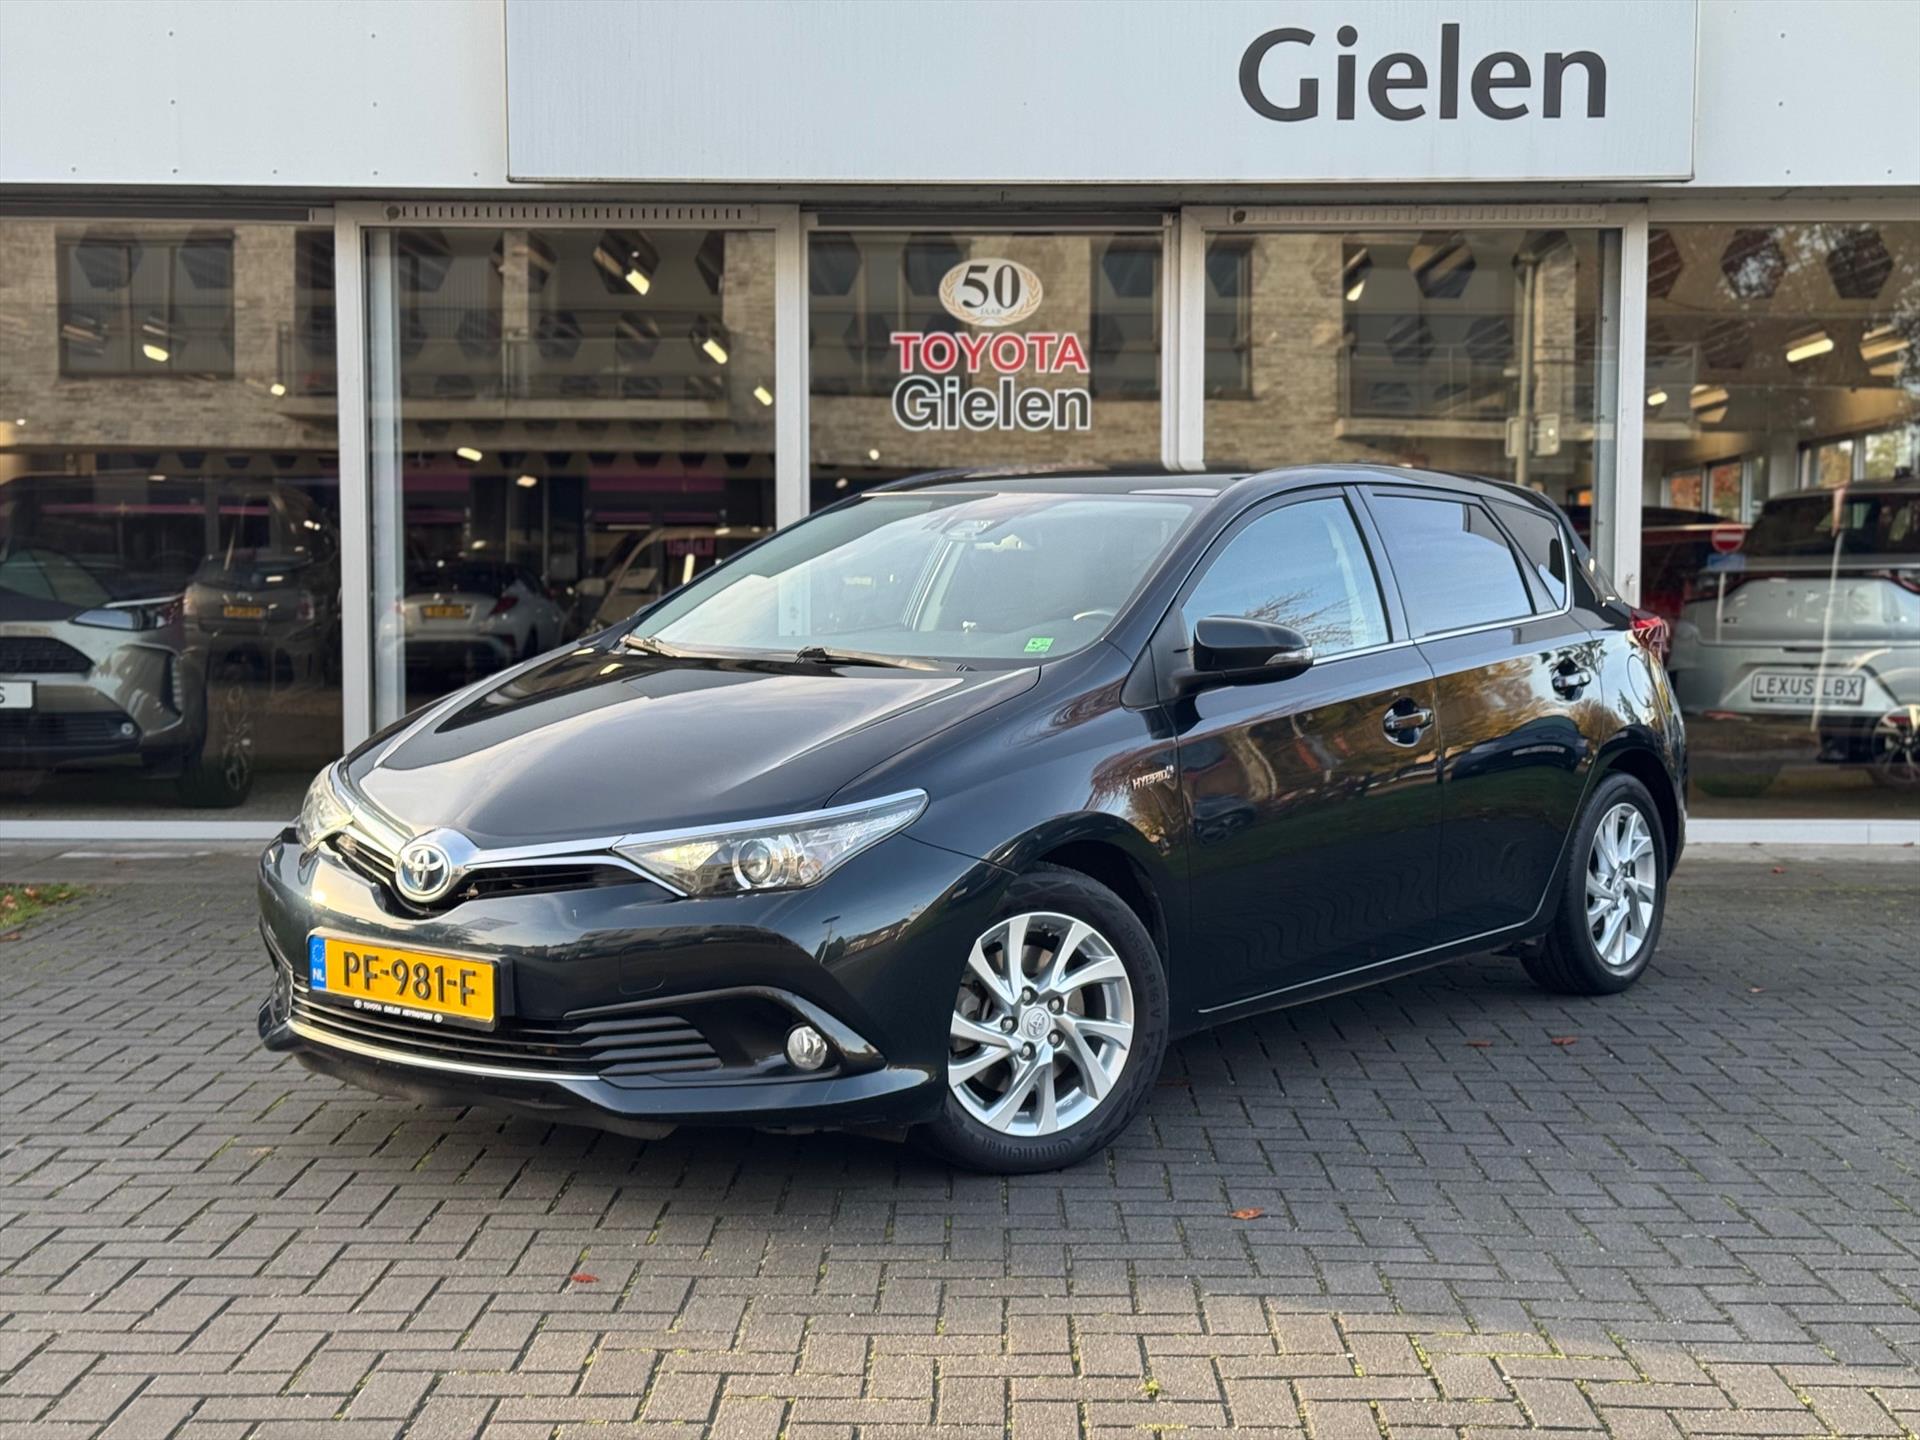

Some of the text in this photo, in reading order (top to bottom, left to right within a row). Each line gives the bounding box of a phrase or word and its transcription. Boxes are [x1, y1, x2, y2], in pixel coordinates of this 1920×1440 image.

[1239, 23, 1607, 122] Gielen
[962, 264, 1021, 309] 50
[891, 332, 1090, 374] TOYOTA
[892, 375, 1091, 431] Gielen
[1755, 676, 1859, 698] LEXUS LBX
[312, 967, 325, 981] NL
[343, 951, 477, 1007] PF-981-F
